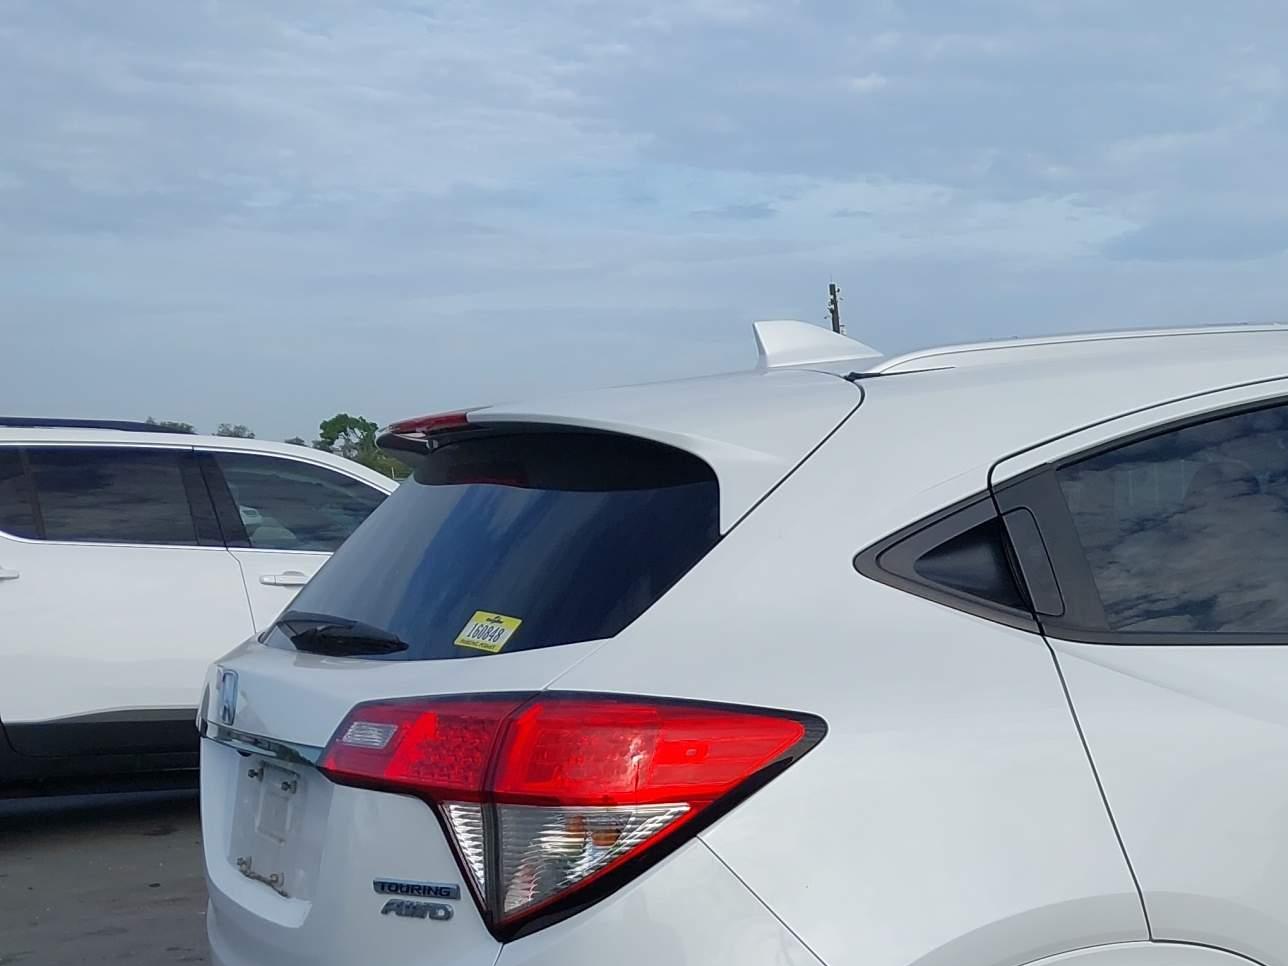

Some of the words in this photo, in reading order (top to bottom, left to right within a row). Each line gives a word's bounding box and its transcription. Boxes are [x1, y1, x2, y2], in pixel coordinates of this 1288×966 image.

[466, 622, 505, 643] 160848
[378, 881, 451, 897] TOURING
[380, 898, 454, 921] AWD
